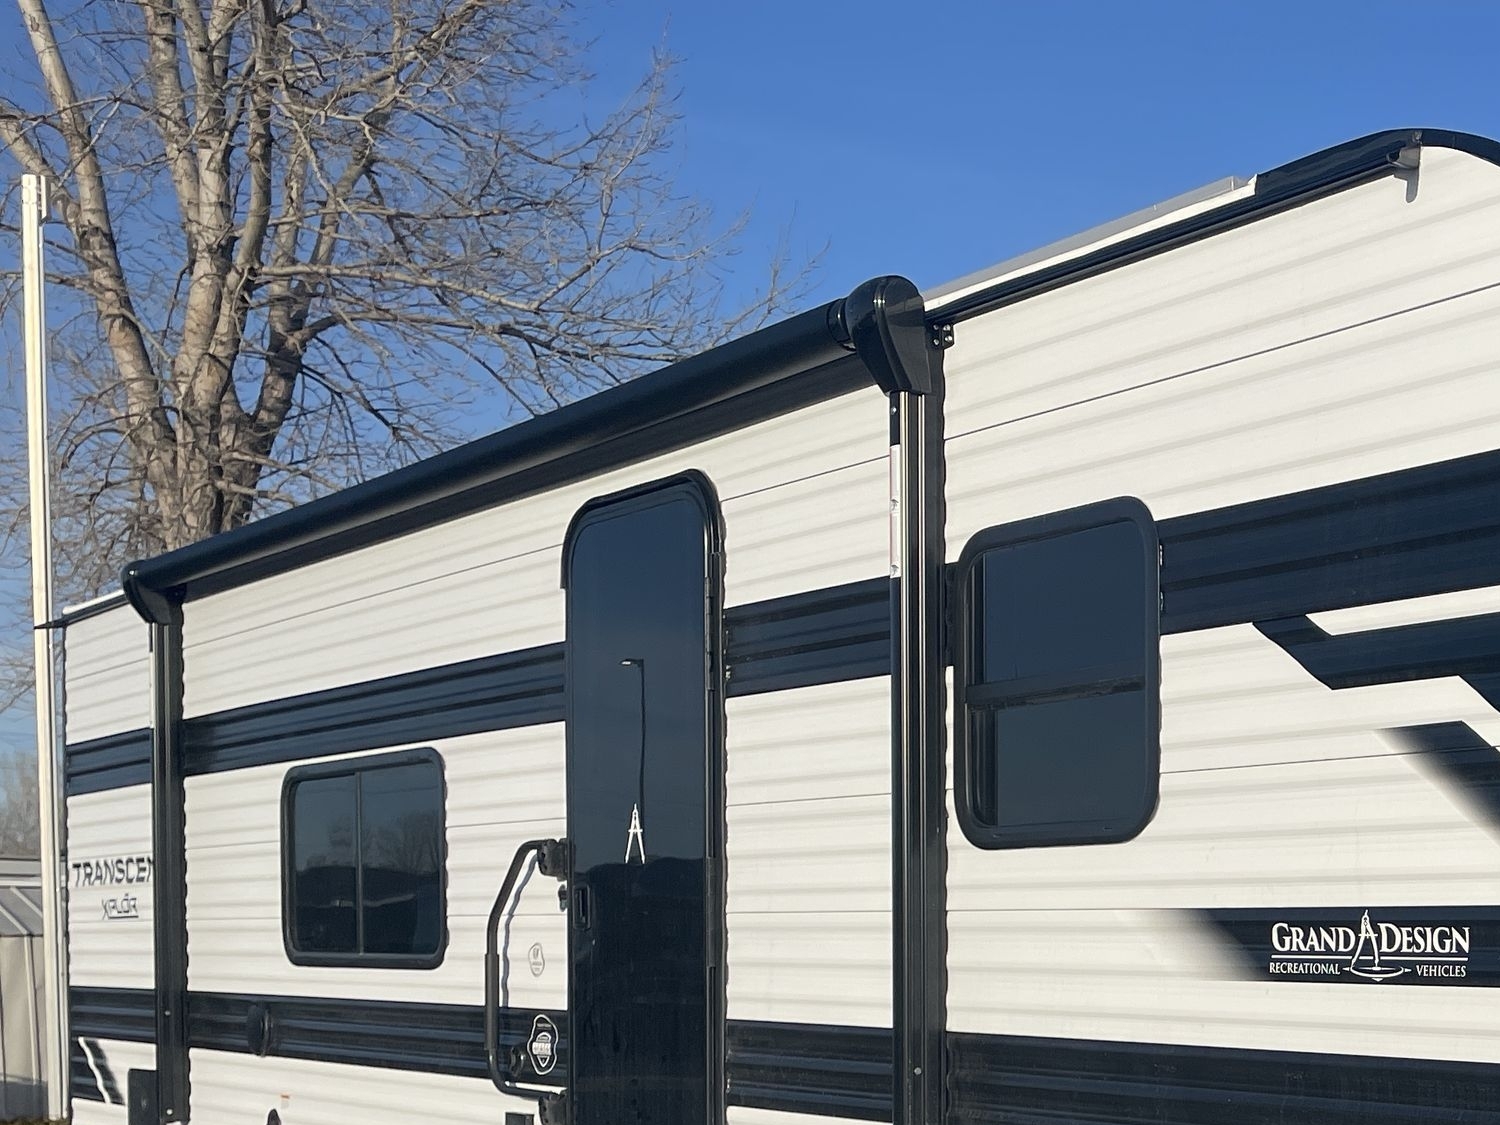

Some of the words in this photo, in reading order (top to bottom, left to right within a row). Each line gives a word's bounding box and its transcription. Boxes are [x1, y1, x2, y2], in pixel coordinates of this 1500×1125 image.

[72, 856, 154, 888] TRANSCEN
[1271, 922, 1356, 952] GRAND
[1377, 922, 1470, 954] DESIGN
[1269, 962, 1341, 975] RECREATIONAL
[1416, 964, 1467, 978] VEHICLES
